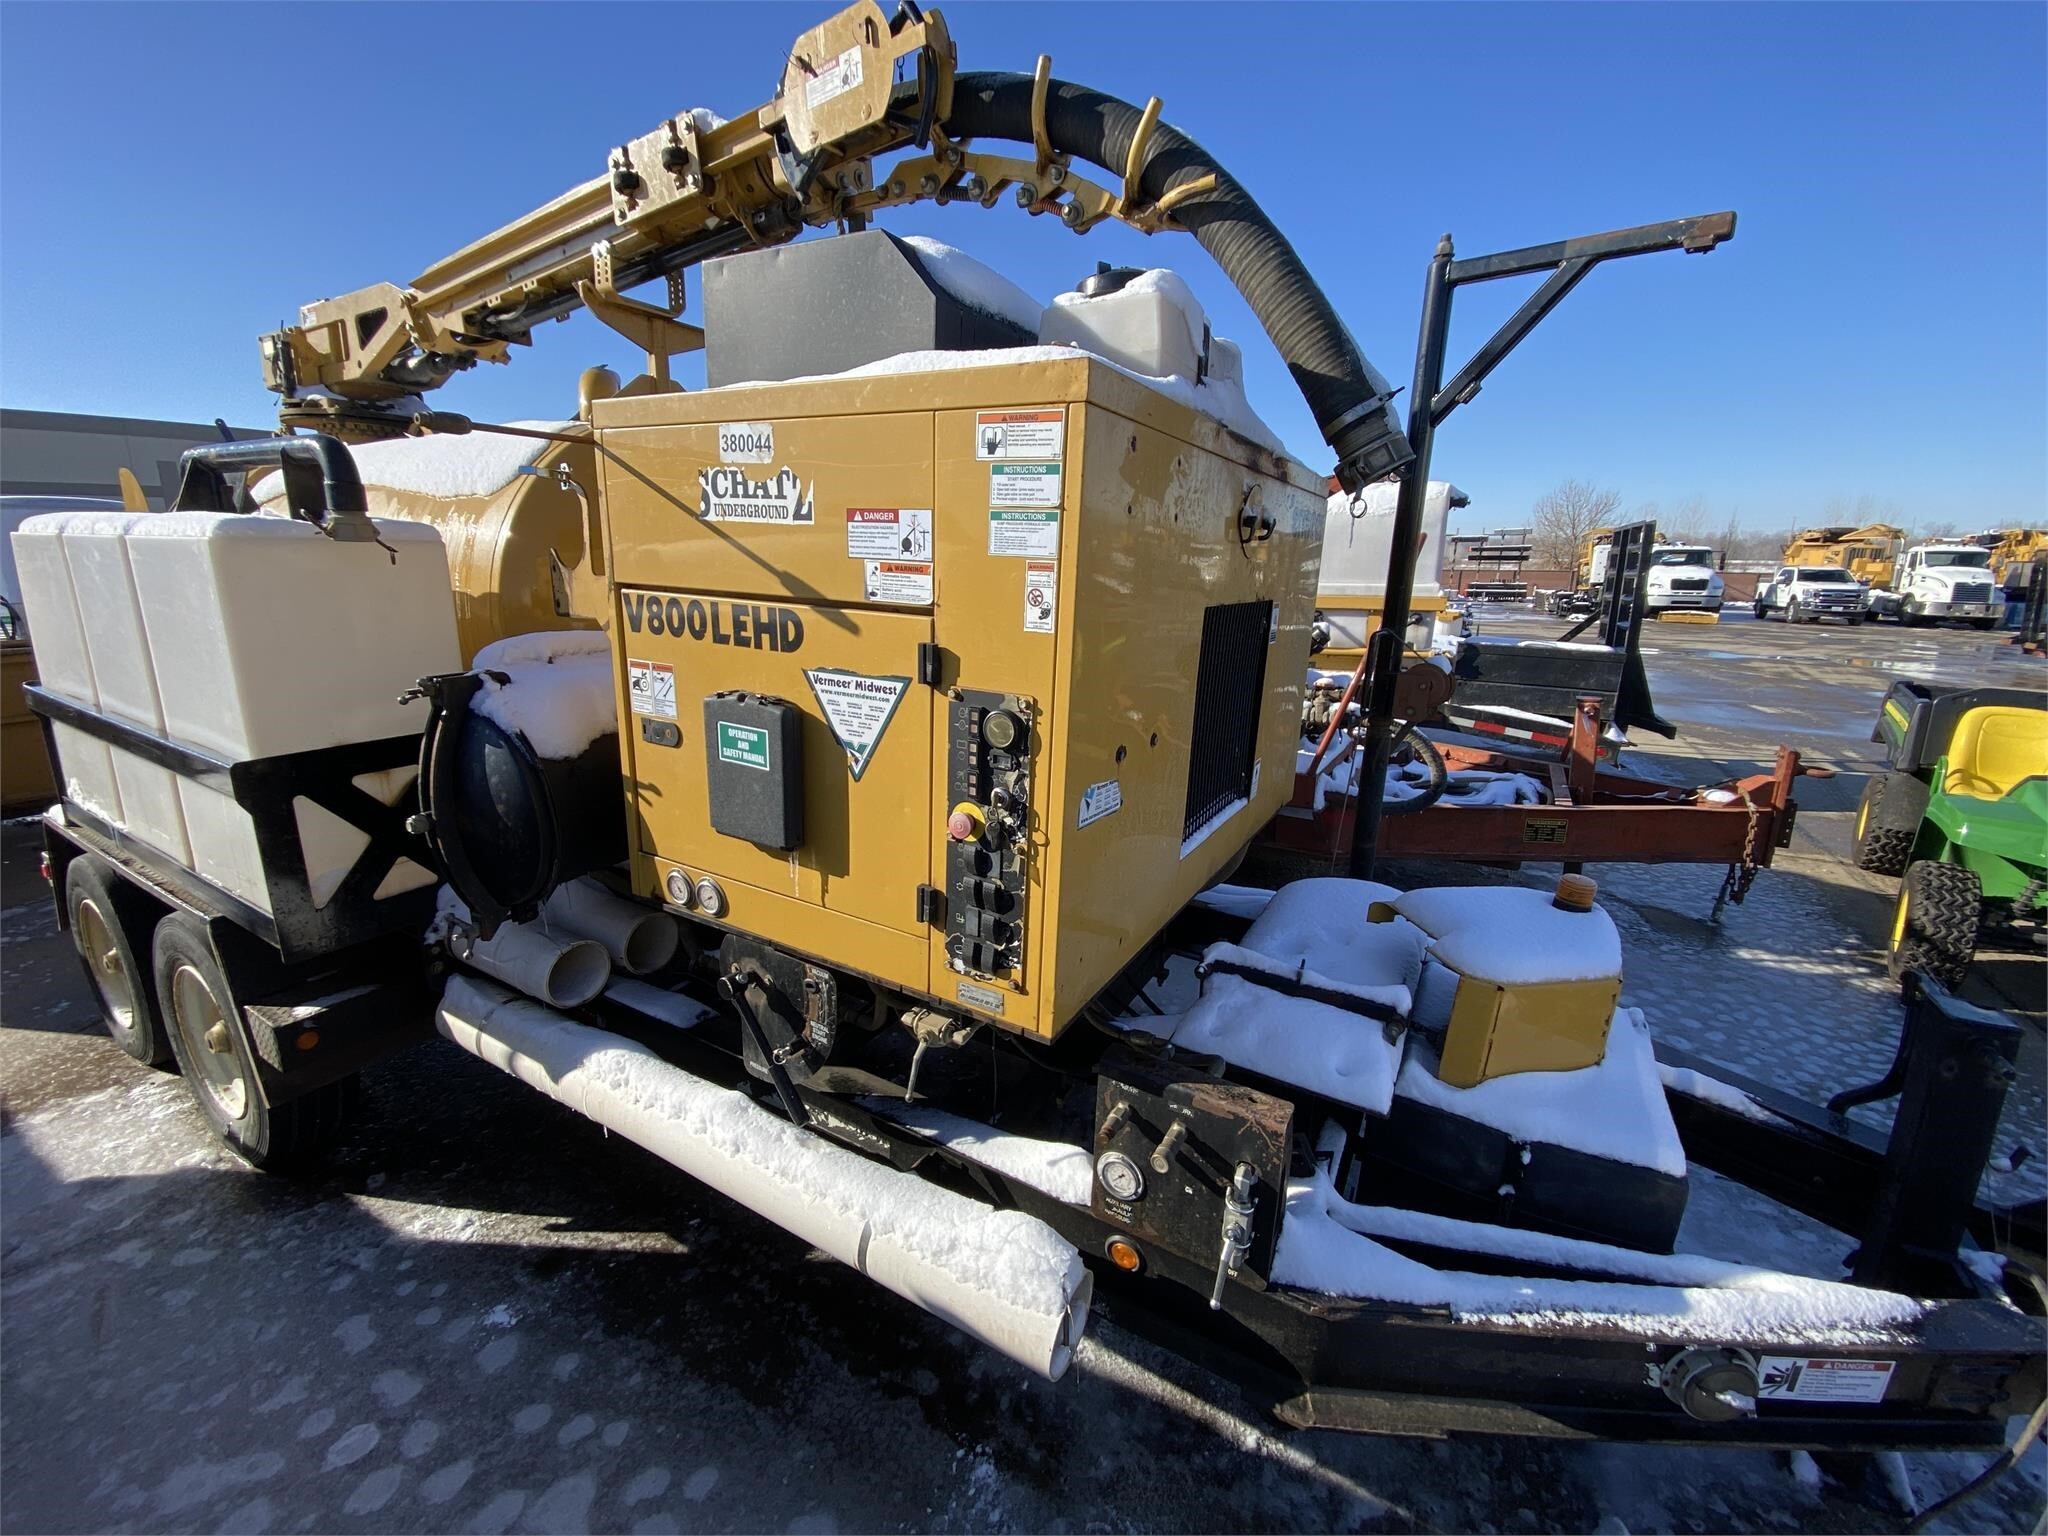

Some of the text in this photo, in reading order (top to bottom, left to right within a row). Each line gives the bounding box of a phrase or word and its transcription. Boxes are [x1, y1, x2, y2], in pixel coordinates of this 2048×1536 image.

[721, 434, 771, 452] 380044
[1003, 465, 1047, 473] INSTRUCTIONS
[714, 503, 788, 519] UNDERGROUND
[864, 512, 894, 520] DANGER
[1001, 512, 1046, 520] INSTRUCTIONS
[895, 564, 923, 573] WARNING
[623, 593, 804, 653] V800LEHD
[813, 673, 897, 695] Vermeer Midwest
[821, 688, 890, 703] www.vermeermidwest.com
[728, 728, 758, 742] OPERATION
[738, 740, 749, 750] AND
[723, 747, 765, 764] SAFETY MANUAL
[1227, 1268, 1239, 1277] OFF
[1834, 1362, 1875, 1370] DANGER
